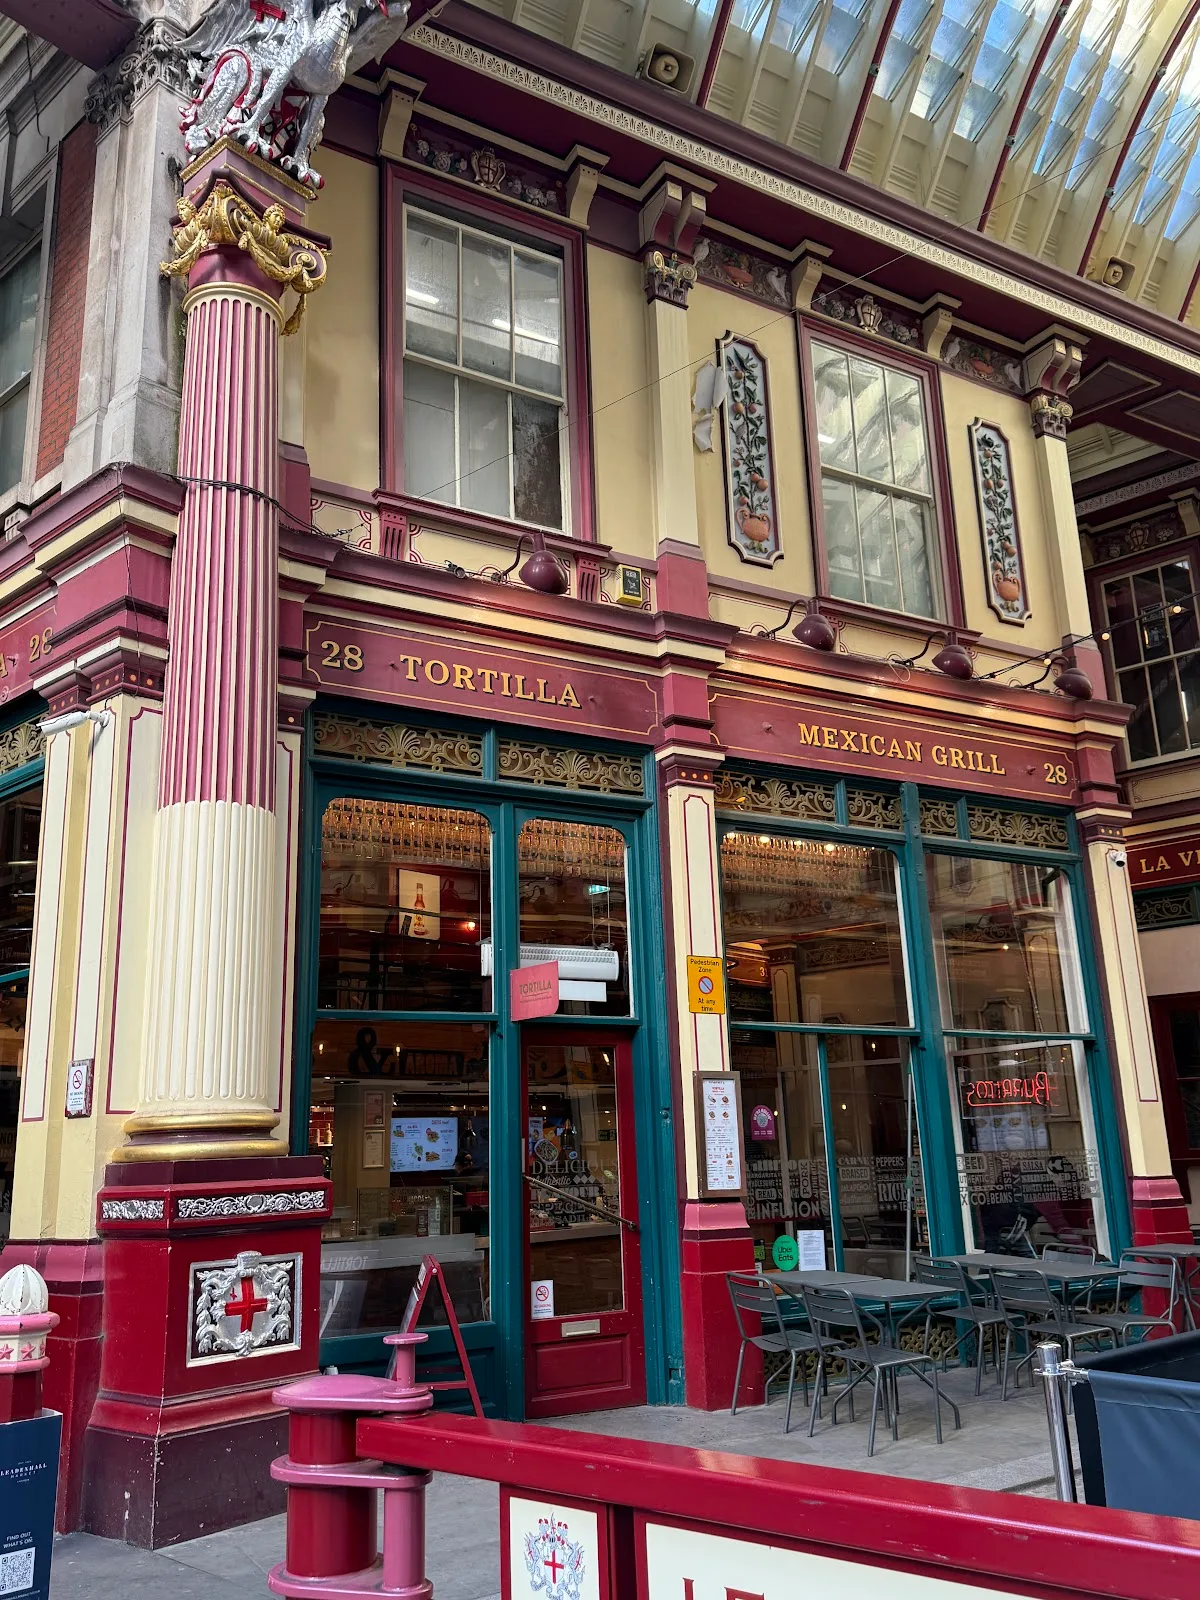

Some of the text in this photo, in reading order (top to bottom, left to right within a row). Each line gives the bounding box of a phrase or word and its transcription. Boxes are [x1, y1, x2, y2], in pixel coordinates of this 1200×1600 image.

[321, 640, 582, 708] 28 TORTILLA
[798, 723, 1069, 785] MEXICAN GRILL 28
[1140, 855, 1171, 874] LA
[690, 958, 720, 967] Pedestrian
[519, 980, 552, 995] TORTILLA
[876, 1156, 905, 1168] PEPPERS
[1022, 1161, 1044, 1171] SALSA
[841, 1168, 868, 1179] BRAISED
[1077, 1163, 1099, 1179] BEEF
[801, 1162, 809, 1195] PORK
[757, 1190, 775, 1199] REAL
[990, 1192, 1013, 1204] BEANS
[757, 1200, 821, 1219] INFUSION
[778, 1246, 792, 1254] Uber
[0, 1462, 47, 1476] LEADENHALL
[6, 1531, 31, 1542] FIND OUT
